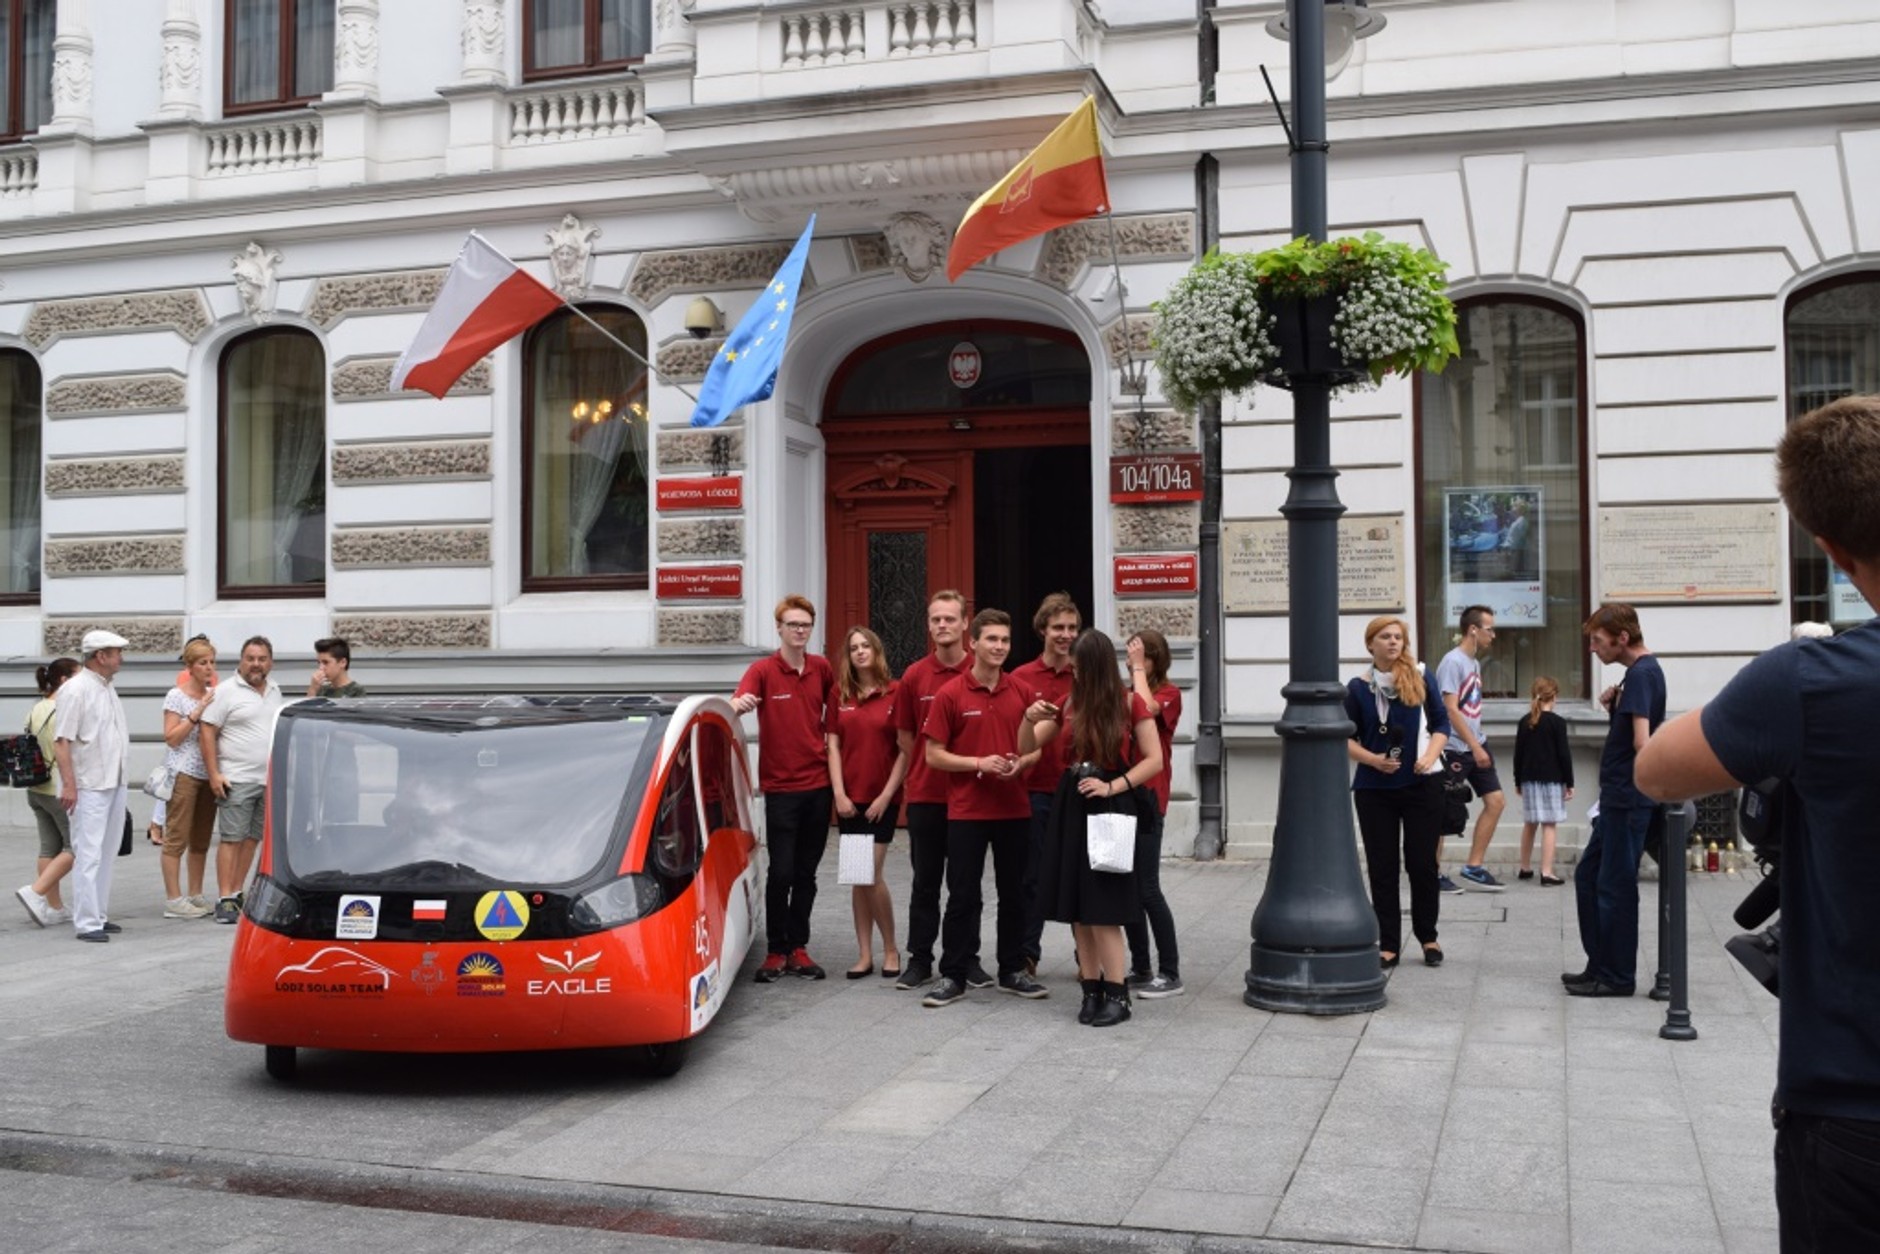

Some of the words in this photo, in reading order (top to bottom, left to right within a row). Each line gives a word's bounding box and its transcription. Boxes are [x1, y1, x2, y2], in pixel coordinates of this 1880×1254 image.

[1120, 463, 1192, 492] 104/104a
[706, 487, 738, 498] ŁÓDZKI
[307, 983, 346, 993] SOLAR
[349, 983, 384, 993] TEAM
[527, 978, 612, 995] EAGLE
